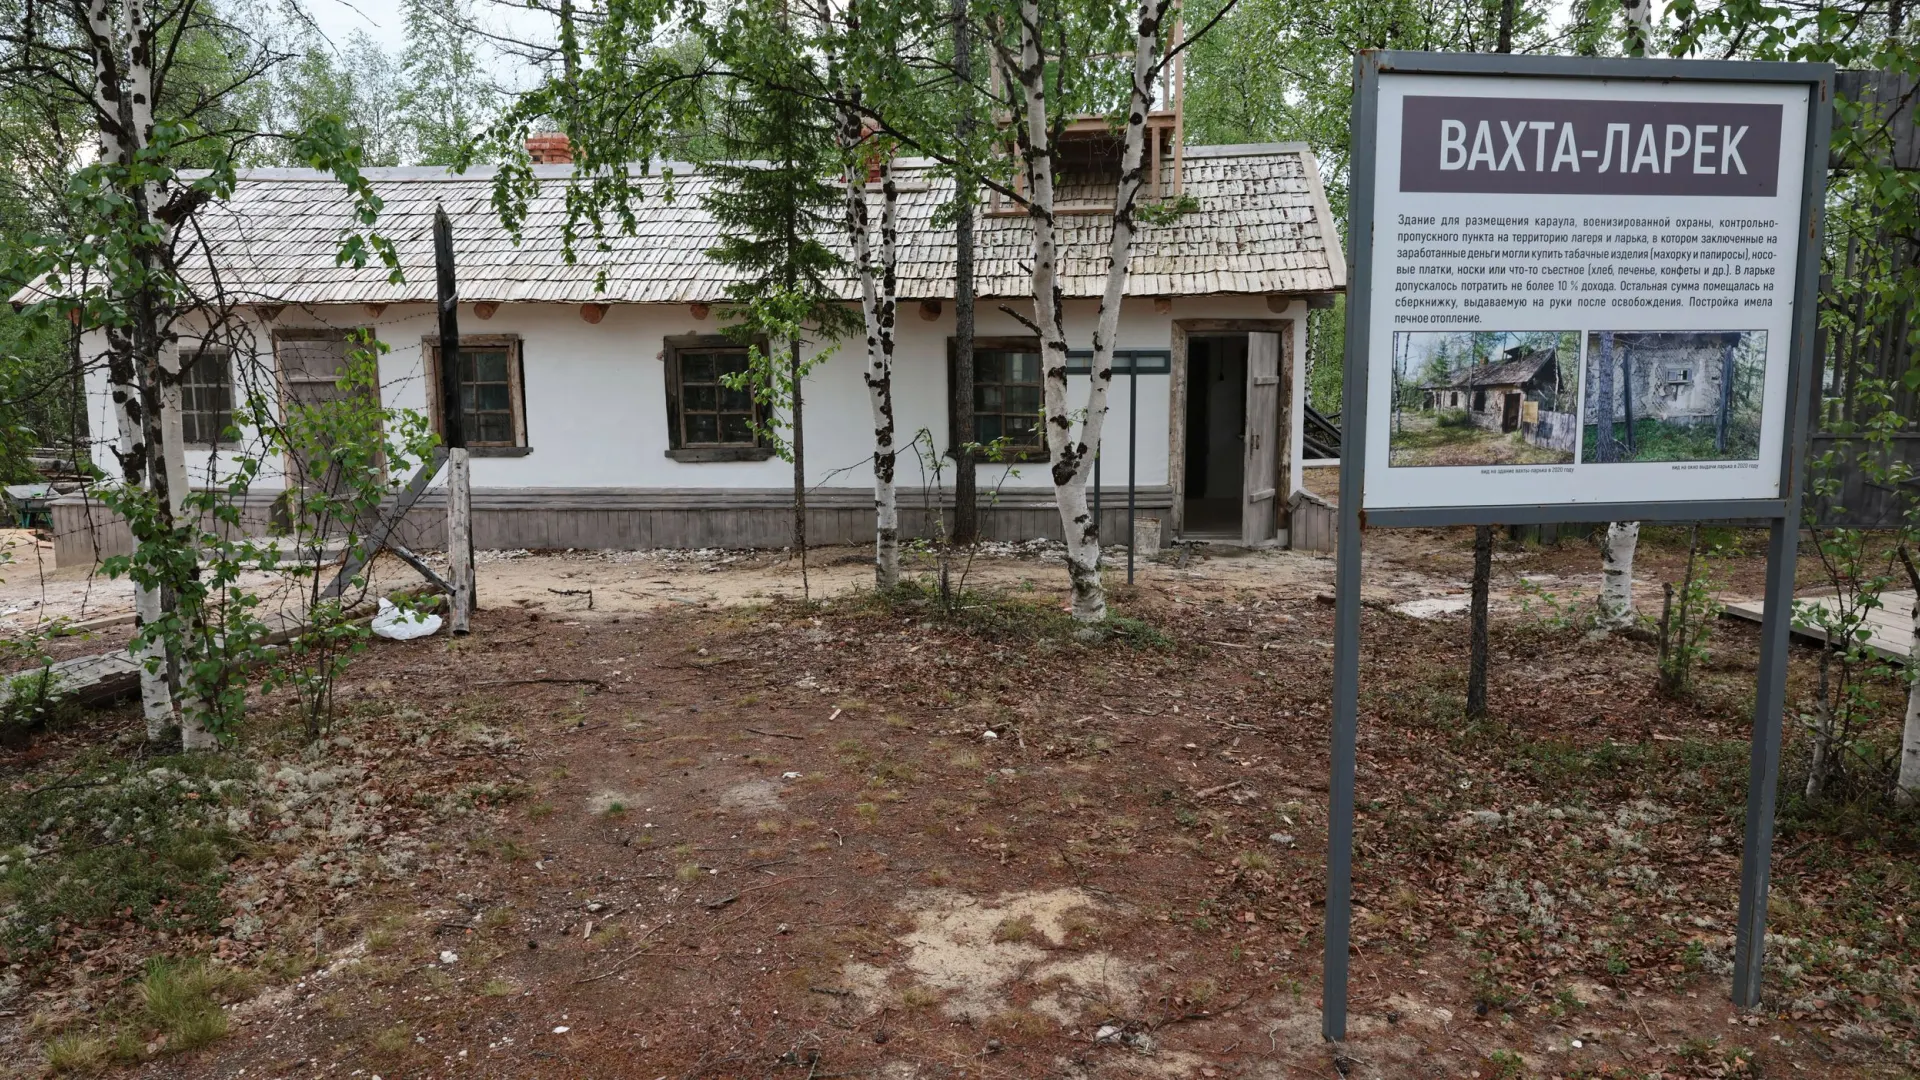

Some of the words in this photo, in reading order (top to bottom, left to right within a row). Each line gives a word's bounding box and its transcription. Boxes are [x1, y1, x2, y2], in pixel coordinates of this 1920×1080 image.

[1439, 118, 1749, 175] ВАХТА-ЛАРЕК
[1398, 213, 1436, 226] Здание
[1441, 214, 1460, 227] для
[1465, 216, 1529, 227] размещения
[1535, 217, 1577, 228] караула,
[1583, 216, 1670, 228] военизированной
[1676, 218, 1714, 229] охраны,
[1719, 218, 1779, 229] контрольно-
[1397, 232, 1459, 244] пропускного
[1462, 232, 1494, 244] пункта
[1498, 233, 1509, 242] на
[1512, 232, 1568, 244] территорию
[1571, 233, 1603, 244] лагеря
[1606, 234, 1611, 243] и
[1615, 234, 1649, 245] ларька,
[1653, 235, 1657, 243] в
[1661, 234, 1698, 245] котором
[1701, 234, 1764, 244] заключенные
[1766, 235, 1777, 244] на
[1397, 247, 1466, 260] заработанные
[1467, 249, 1500, 260] деньги
[1502, 249, 1530, 259] могли
[1531, 249, 1563, 260] купить
[1564, 248, 1609, 259] табачные
[1611, 250, 1648, 260] изделия
[1693, 250, 1699, 259] и
[1752, 250, 1777, 259] носо-
[1396, 265, 1415, 274] вые
[1419, 265, 1454, 276] платки,
[1457, 265, 1485, 274] носки
[1489, 265, 1506, 274] или
[1509, 265, 1538, 275] что-то
[1542, 265, 1584, 275] съестное
[1618, 265, 1657, 276] печенье,
[1660, 265, 1700, 277] конфеты
[1704, 266, 1709, 275] и
[1735, 264, 1741, 275] В
[1743, 266, 1775, 277] ларьке
[1395, 281, 1457, 293] допускалось
[1461, 281, 1508, 292] потратить
[1511, 281, 1522, 291] не
[1526, 280, 1554, 291] более
[1558, 280, 1567, 291] 10
[1570, 280, 1579, 291] %
[1581, 281, 1616, 292] дохода.
[1620, 280, 1667, 291] Остальная
[1671, 282, 1699, 293] сумма
[1703, 282, 1760, 292] помещалась
[1763, 282, 1774, 291] на
[1395, 296, 1458, 309] сберкнижку,
[1464, 297, 1527, 309] выдаваемую
[1533, 297, 1544, 307] на
[1549, 297, 1572, 309] руки
[1578, 297, 1606, 307] после
[1611, 296, 1683, 308] освобождения.
[1689, 295, 1738, 308] Постройка
[1744, 297, 1772, 307] имела
[1394, 313, 1428, 324] печное
[1430, 313, 1482, 324] отопление.
